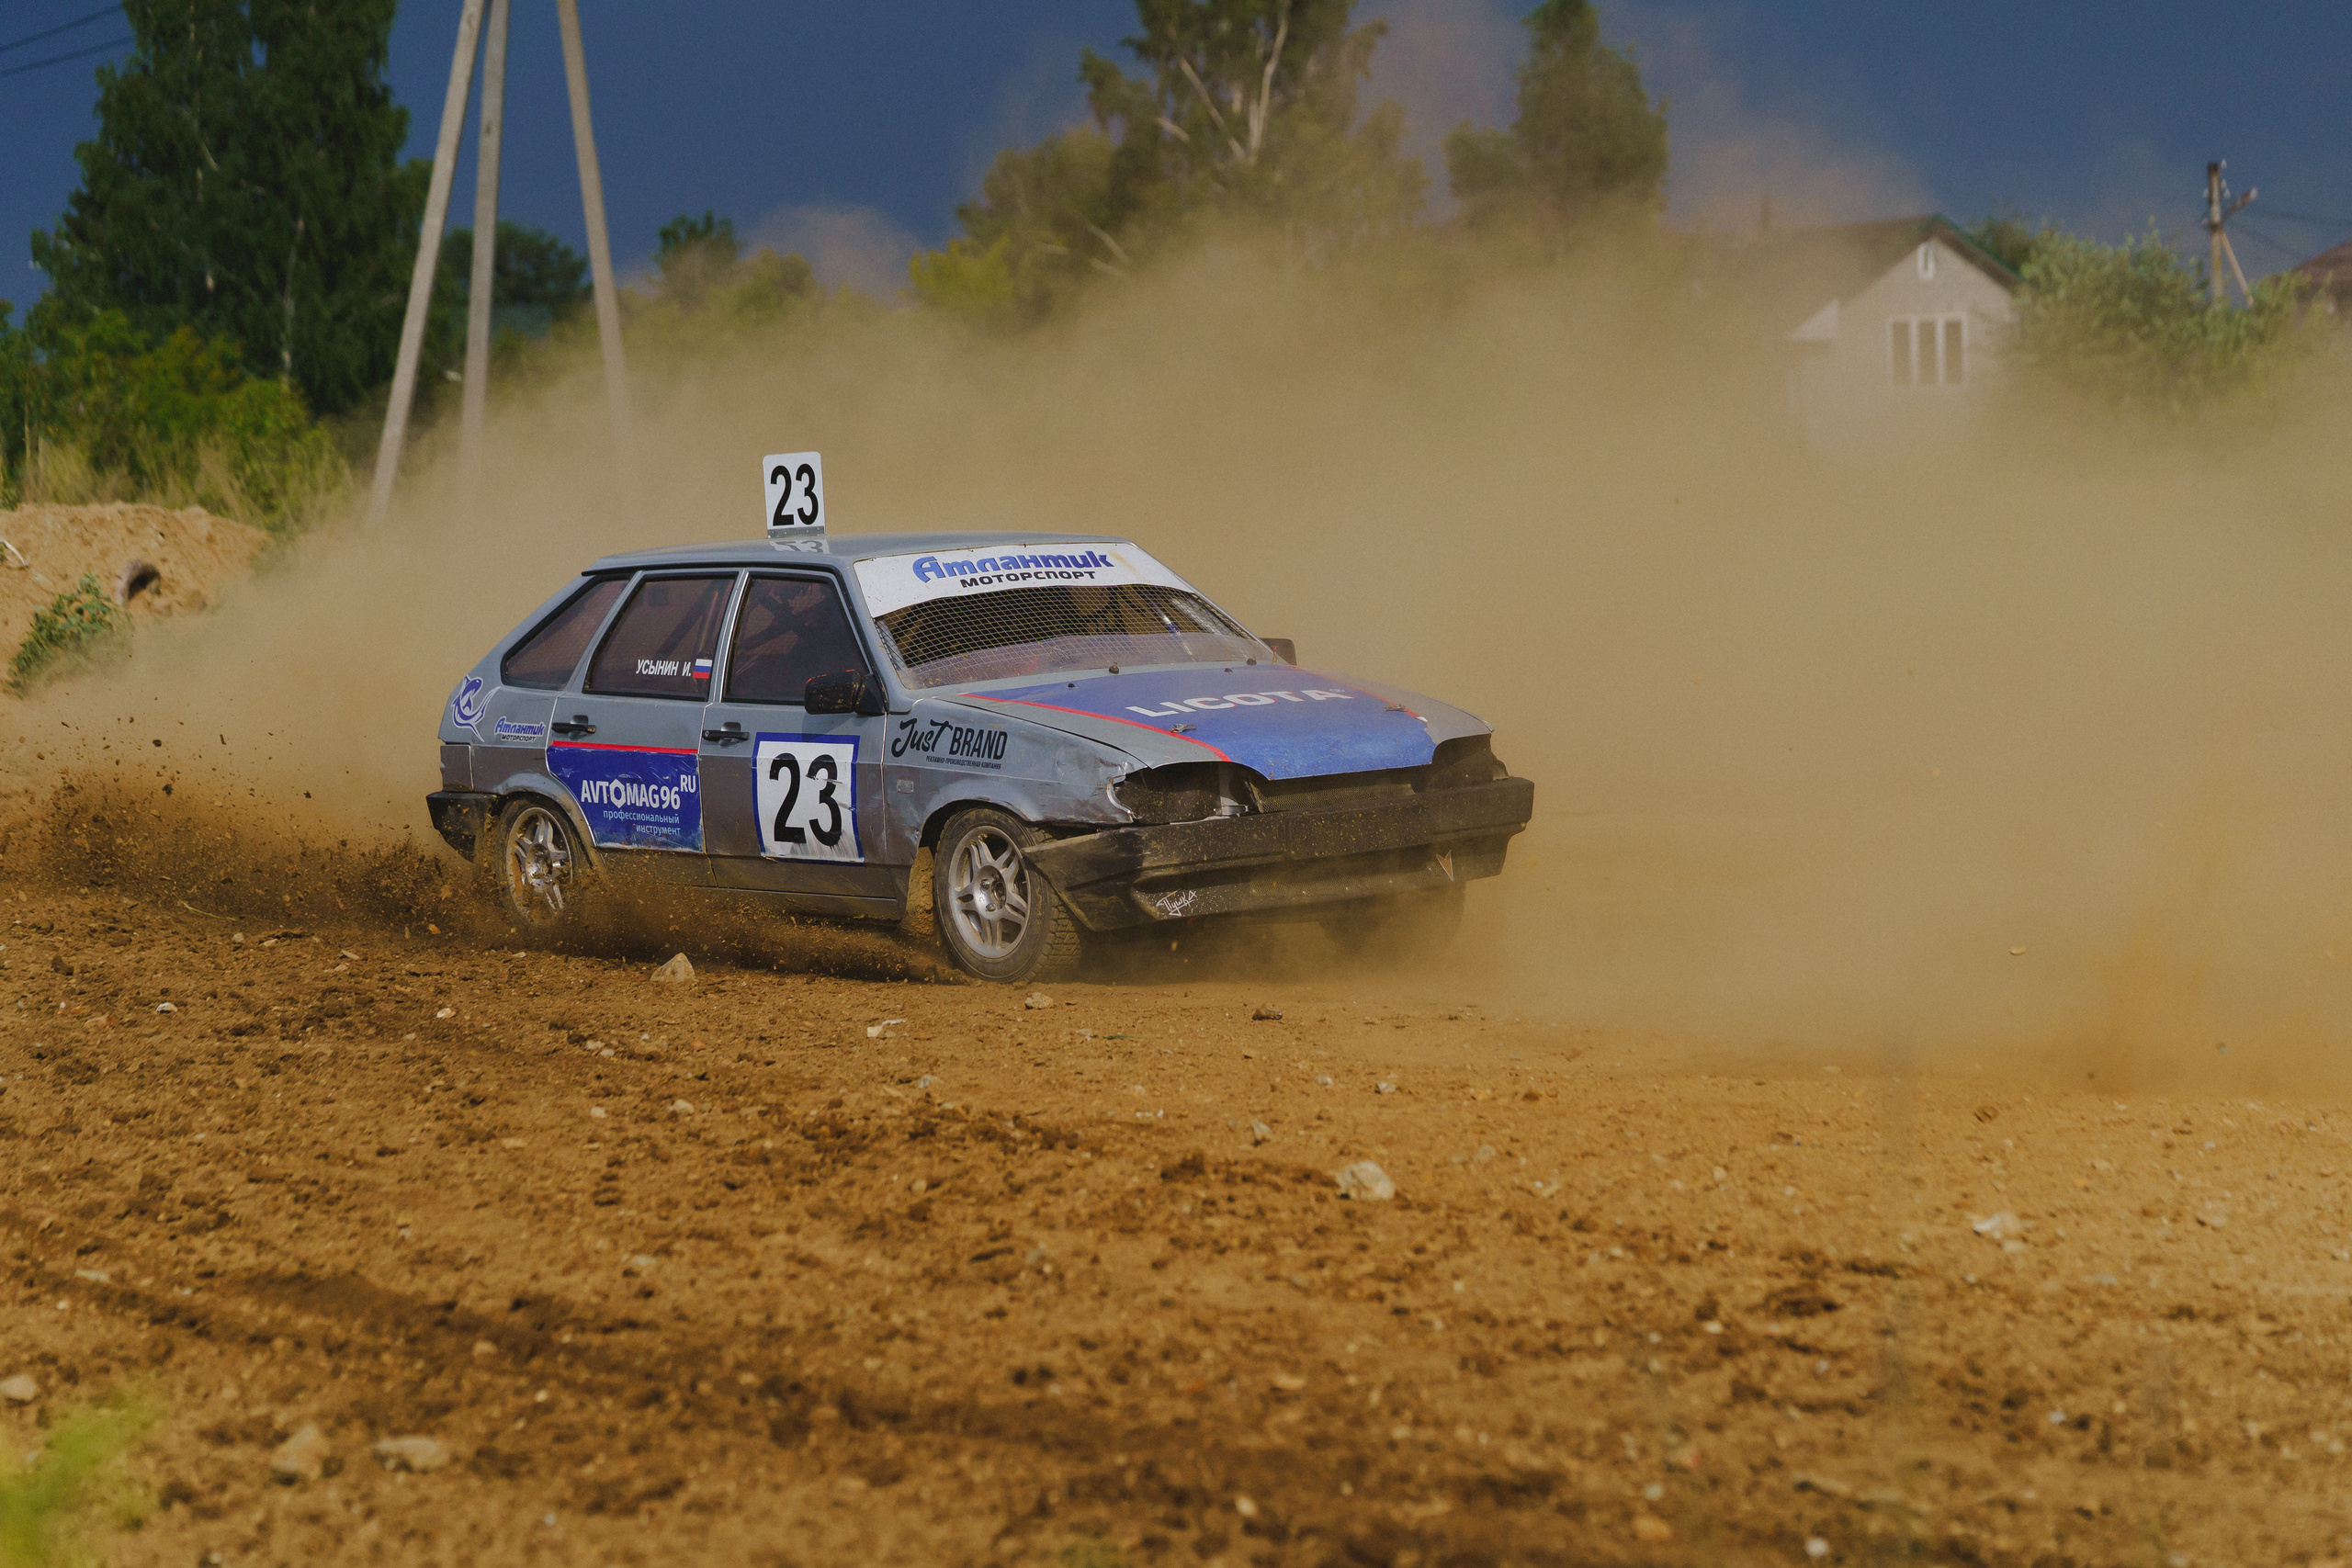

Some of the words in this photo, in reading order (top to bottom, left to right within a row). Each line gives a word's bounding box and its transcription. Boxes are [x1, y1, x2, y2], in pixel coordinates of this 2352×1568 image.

[770, 463, 820, 526] 23
[912, 551, 1114, 583] Атлантик
[959, 570, 1096, 588] МОТОРСПОРТ
[636, 659, 679, 676] УСЫНИН
[682, 661, 692, 677] И.
[1125, 689, 1354, 717] LICOTA
[495, 716, 545, 736] Атлантик
[948, 727, 1008, 761] BRAND
[581, 778, 681, 810] AVTOMAG96
[680, 774, 696, 793] RU
[769, 752, 842, 847] 23
[603, 809, 680, 824] профессиональный
[636, 825, 681, 837] инструмент
